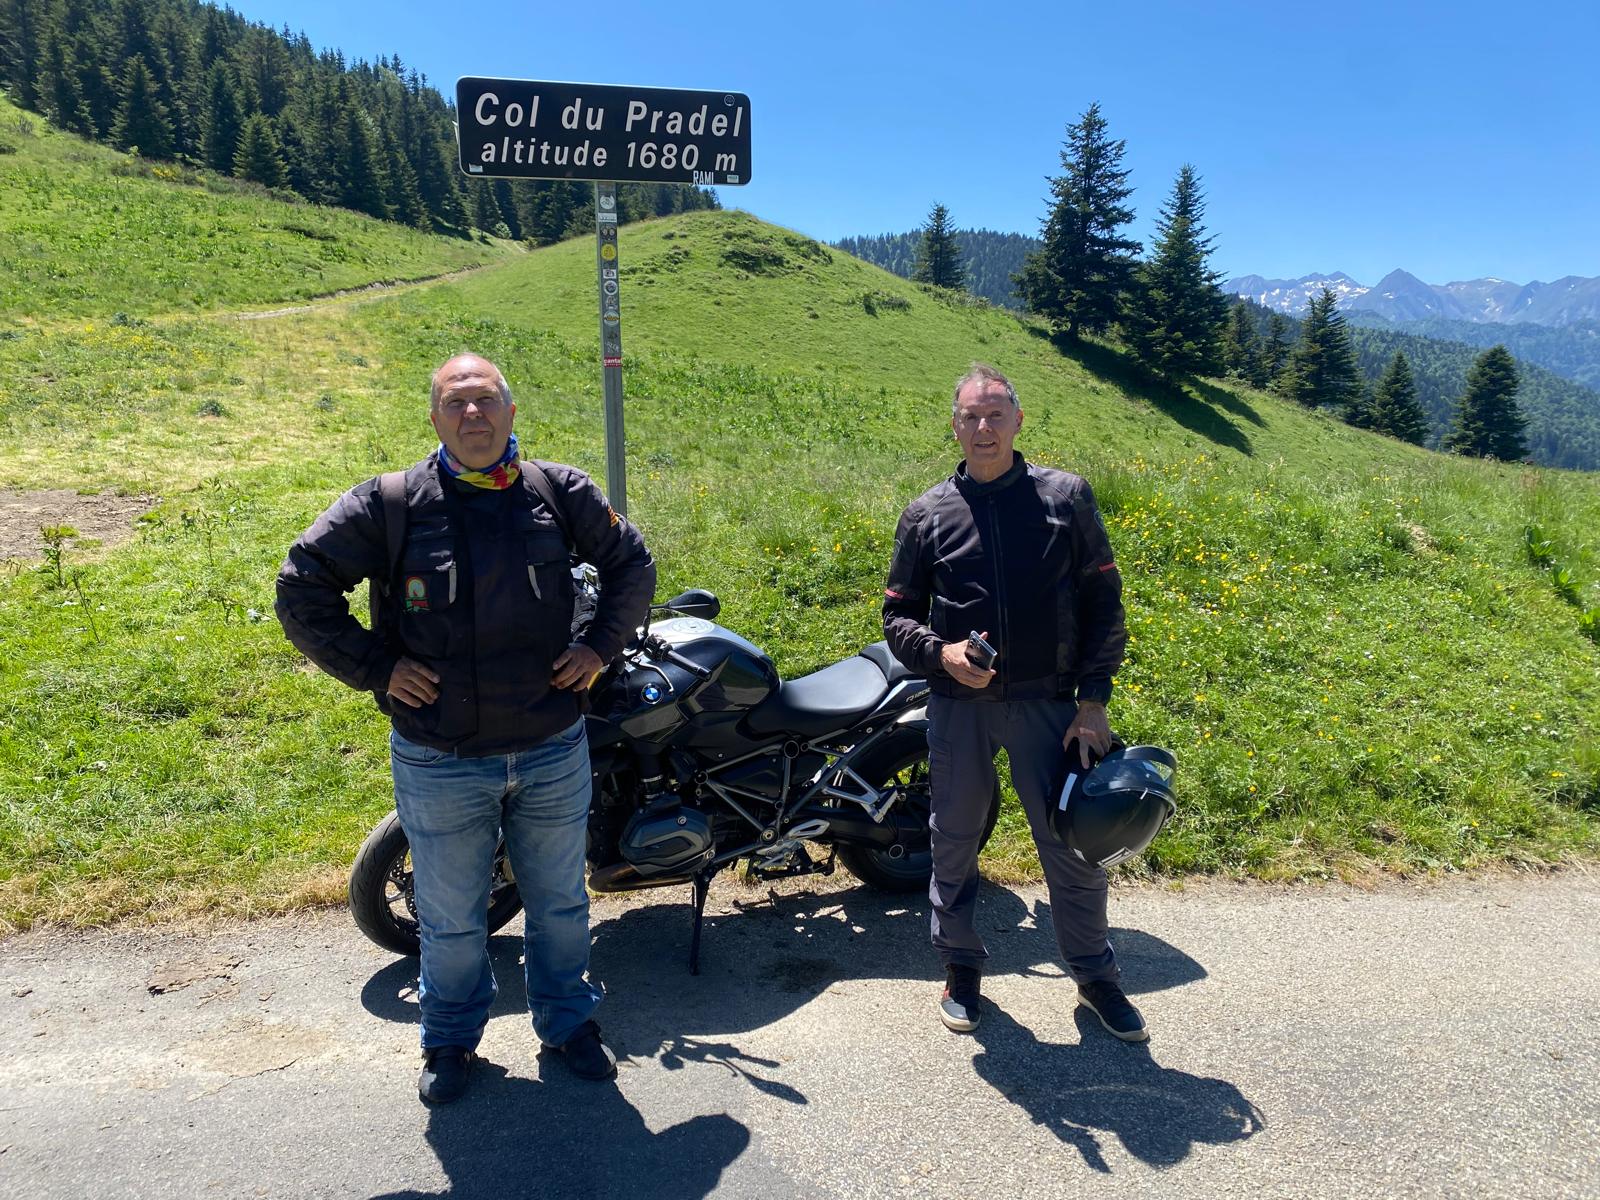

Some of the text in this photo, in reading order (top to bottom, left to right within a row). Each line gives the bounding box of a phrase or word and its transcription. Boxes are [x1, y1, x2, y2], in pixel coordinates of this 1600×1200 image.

[475, 92, 743, 137] Col du Pradel
[481, 136, 737, 172] altitude 1680 m
[692, 170, 714, 185] RAMI
